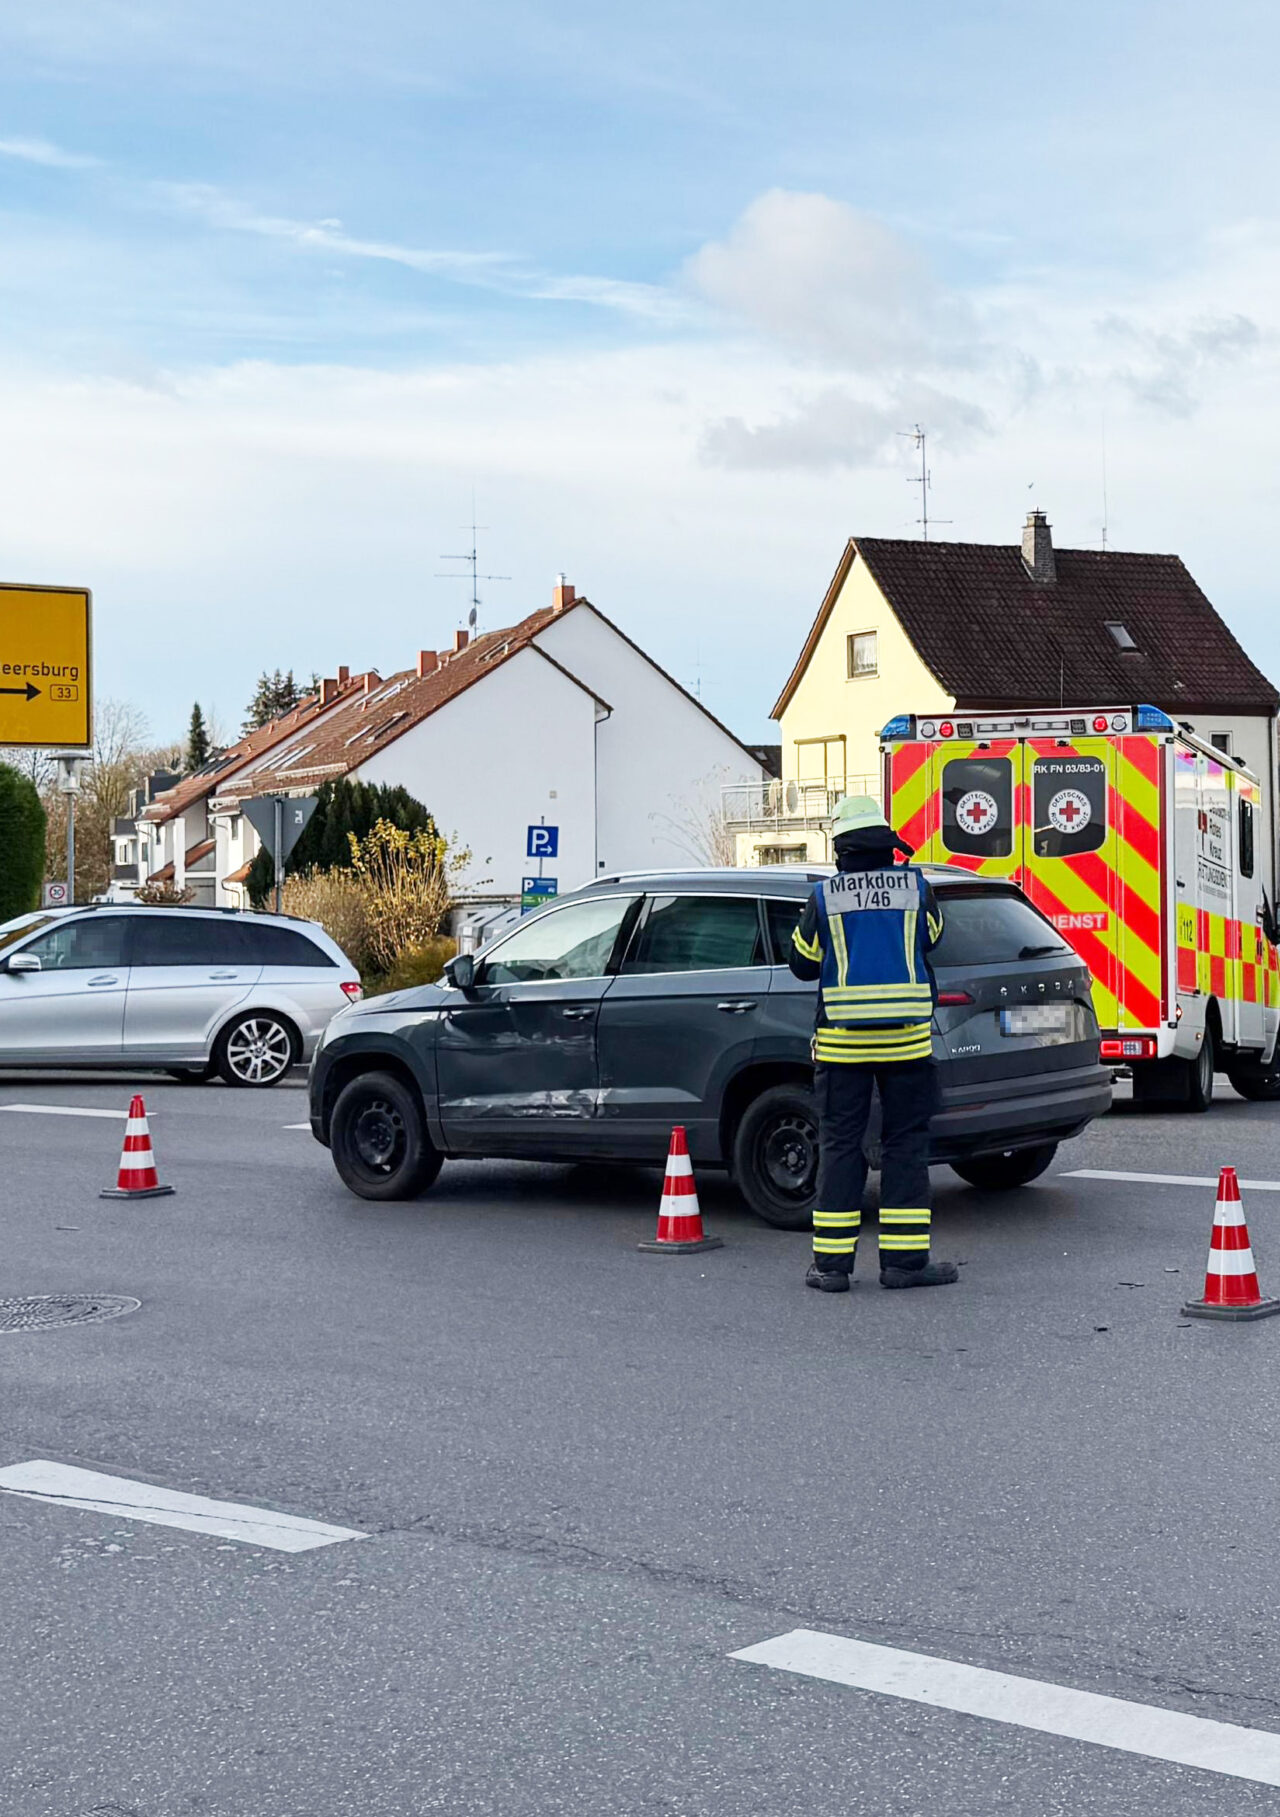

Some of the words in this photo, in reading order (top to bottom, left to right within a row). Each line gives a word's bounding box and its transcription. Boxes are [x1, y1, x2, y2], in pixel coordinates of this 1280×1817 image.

[1, 661, 79, 681] eersburg
[57, 687, 72, 698] 33
[1034, 765, 1048, 773] RK
[1050, 765, 1063, 773] FN
[1065, 764, 1104, 773] 03/83-01
[531, 829, 549, 854] P
[524, 879, 534, 892] P
[830, 872, 909, 894] Markdorf
[854, 891, 891, 908] 1/46
[1051, 914, 1105, 928] IENST
[1183, 918, 1193, 942] 112
